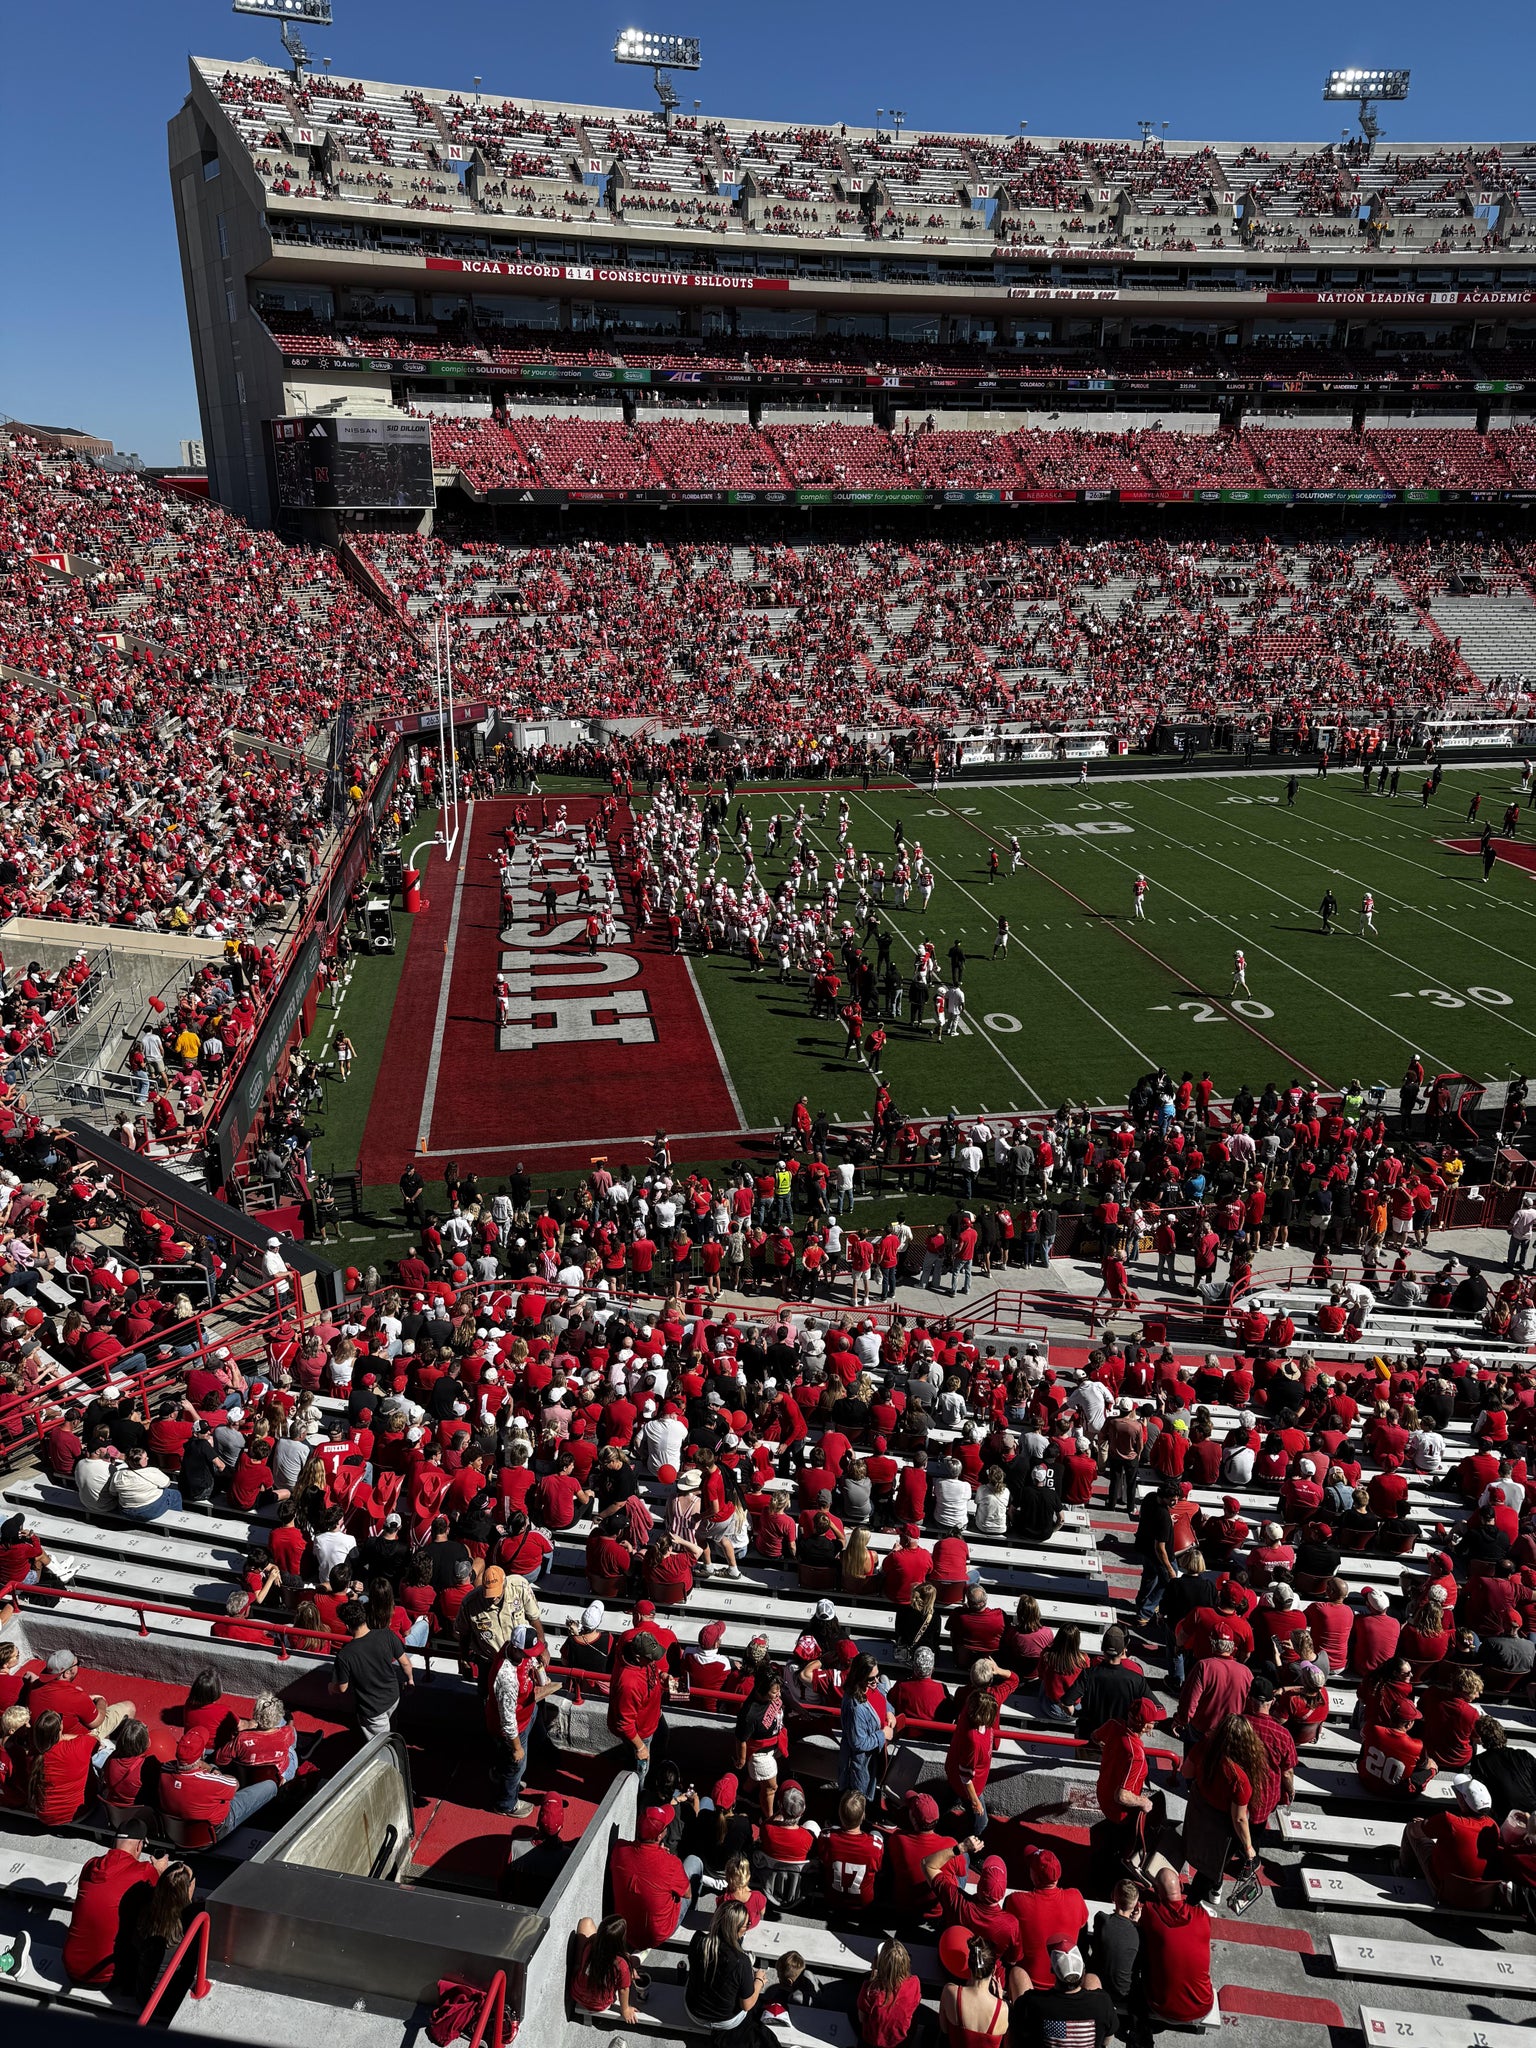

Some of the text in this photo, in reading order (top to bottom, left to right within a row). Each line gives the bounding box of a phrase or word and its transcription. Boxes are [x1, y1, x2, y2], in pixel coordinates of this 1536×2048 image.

[300, 130, 312, 142] N
[450, 147, 460, 158] N
[590, 160, 600, 170] N
[724, 171, 733, 181] N
[852, 180, 861, 190] N
[978, 187, 988, 196] N
[1100, 190, 1109, 200] N
[1224, 193, 1234, 202] N
[1481, 194, 1491, 203] N
[995, 247, 1136, 260] NATIONAL CHAMPIONSHIPS
[462, 260, 754, 288] NCAA RECORD 414 CONSECUTIVE SELLOUTS
[1317, 293, 1532, 303] NATION LEADING 108 ACADEMIC
[370, 361, 392, 371] Sukup
[403, 363, 426, 372] Sukup
[441, 365, 475, 375] complete
[520, 367, 530, 376] for
[530, 369, 548, 377] your
[548, 369, 582, 379] operation
[593, 370, 615, 379] Sukup
[669, 372, 702, 382] ACC
[882, 377, 900, 387] XII
[314, 466, 329, 483] N
[883, 494, 901, 502] your
[1004, 491, 1013, 500] N
[1346, 494, 1363, 502] your
[1363, 493, 1397, 501] operation
[394, 720, 404, 731] N
[1119, 741, 1128, 755] P
[925, 807, 983, 817] 20
[1078, 802, 1135, 811] 30
[1417, 985, 1515, 1010] 30
[1178, 999, 1275, 1023] 20
[266, 1044, 279, 1072] BINS
[278, 1002, 297, 1045] BETTER
[250, 1070, 264, 1109] Sukup
[230, 1117, 241, 1157] N
[1141, 1369, 1147, 1385] 1
[481, 1393, 489, 1413] 1
[332, 1454, 340, 1474] 1
[1365, 1746, 1406, 1785] 20
[1303, 1821, 1318, 1831] 22
[1363, 1827, 1375, 1836] 21
[10, 1862, 26, 1874] 18
[832, 1860, 867, 1895] 17
[1328, 1879, 1344, 1890] 22
[1358, 1947, 1375, 1959] 22
[1430, 1955, 1444, 1967] 21
[1497, 1963, 1514, 1974] 20
[1220, 2015, 1239, 2027] 24
[1395, 2022, 1414, 2036] 22
[1473, 2032, 1489, 2047] 21
